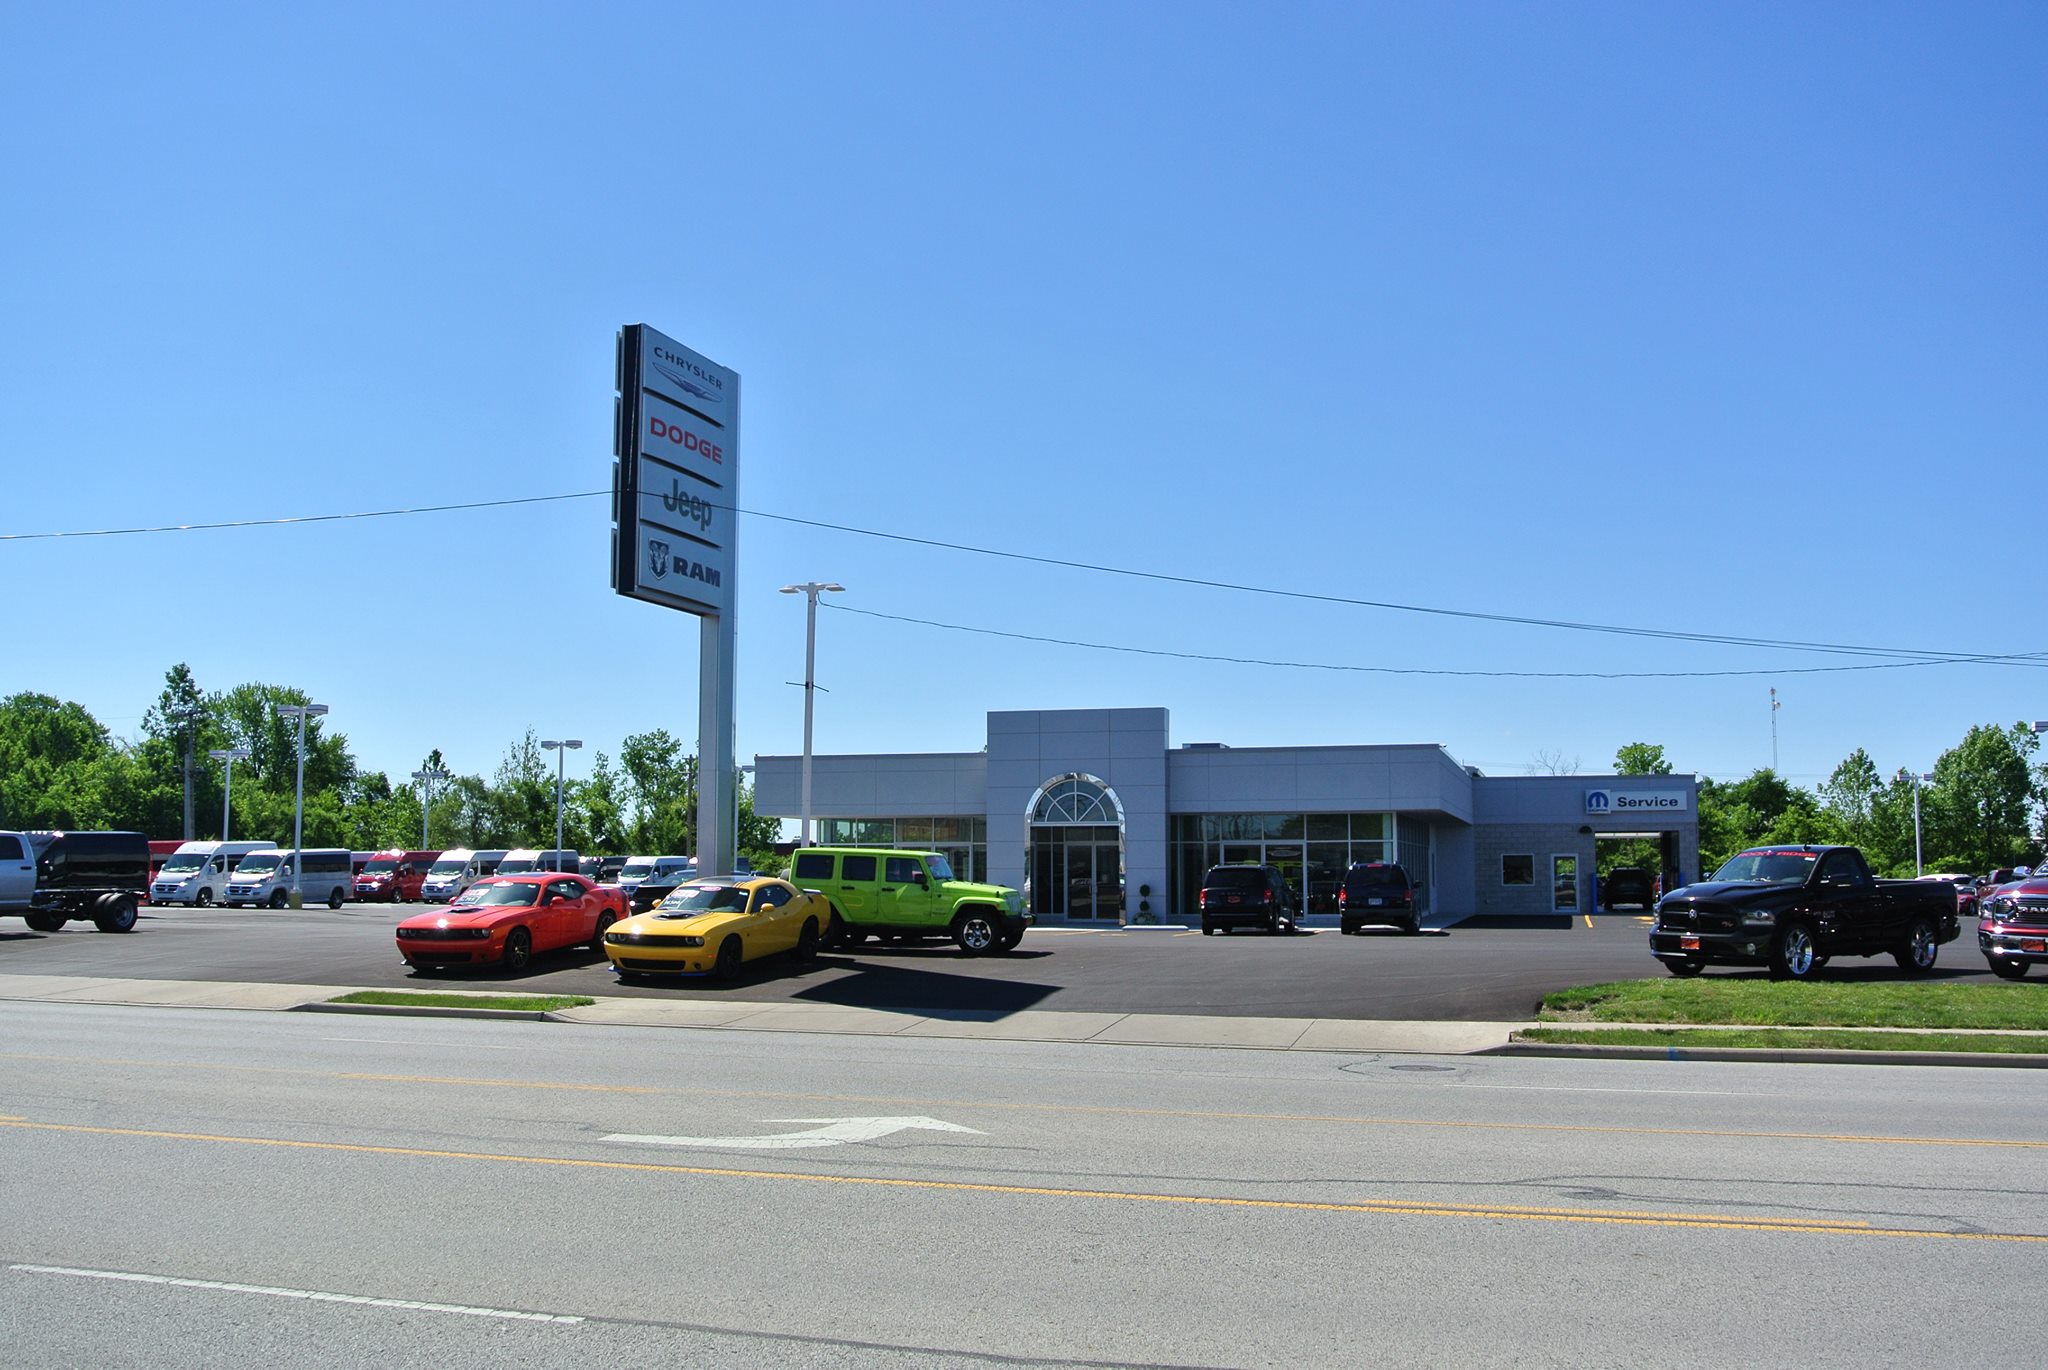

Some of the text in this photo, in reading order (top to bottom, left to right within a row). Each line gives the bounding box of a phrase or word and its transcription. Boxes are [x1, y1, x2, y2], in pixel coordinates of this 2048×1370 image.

[653, 346, 722, 390] CHRYSLER
[650, 416, 722, 465] DODGE
[663, 478, 712, 531] Jeep
[673, 556, 720, 588] RAM
[1617, 796, 1678, 808] Service
